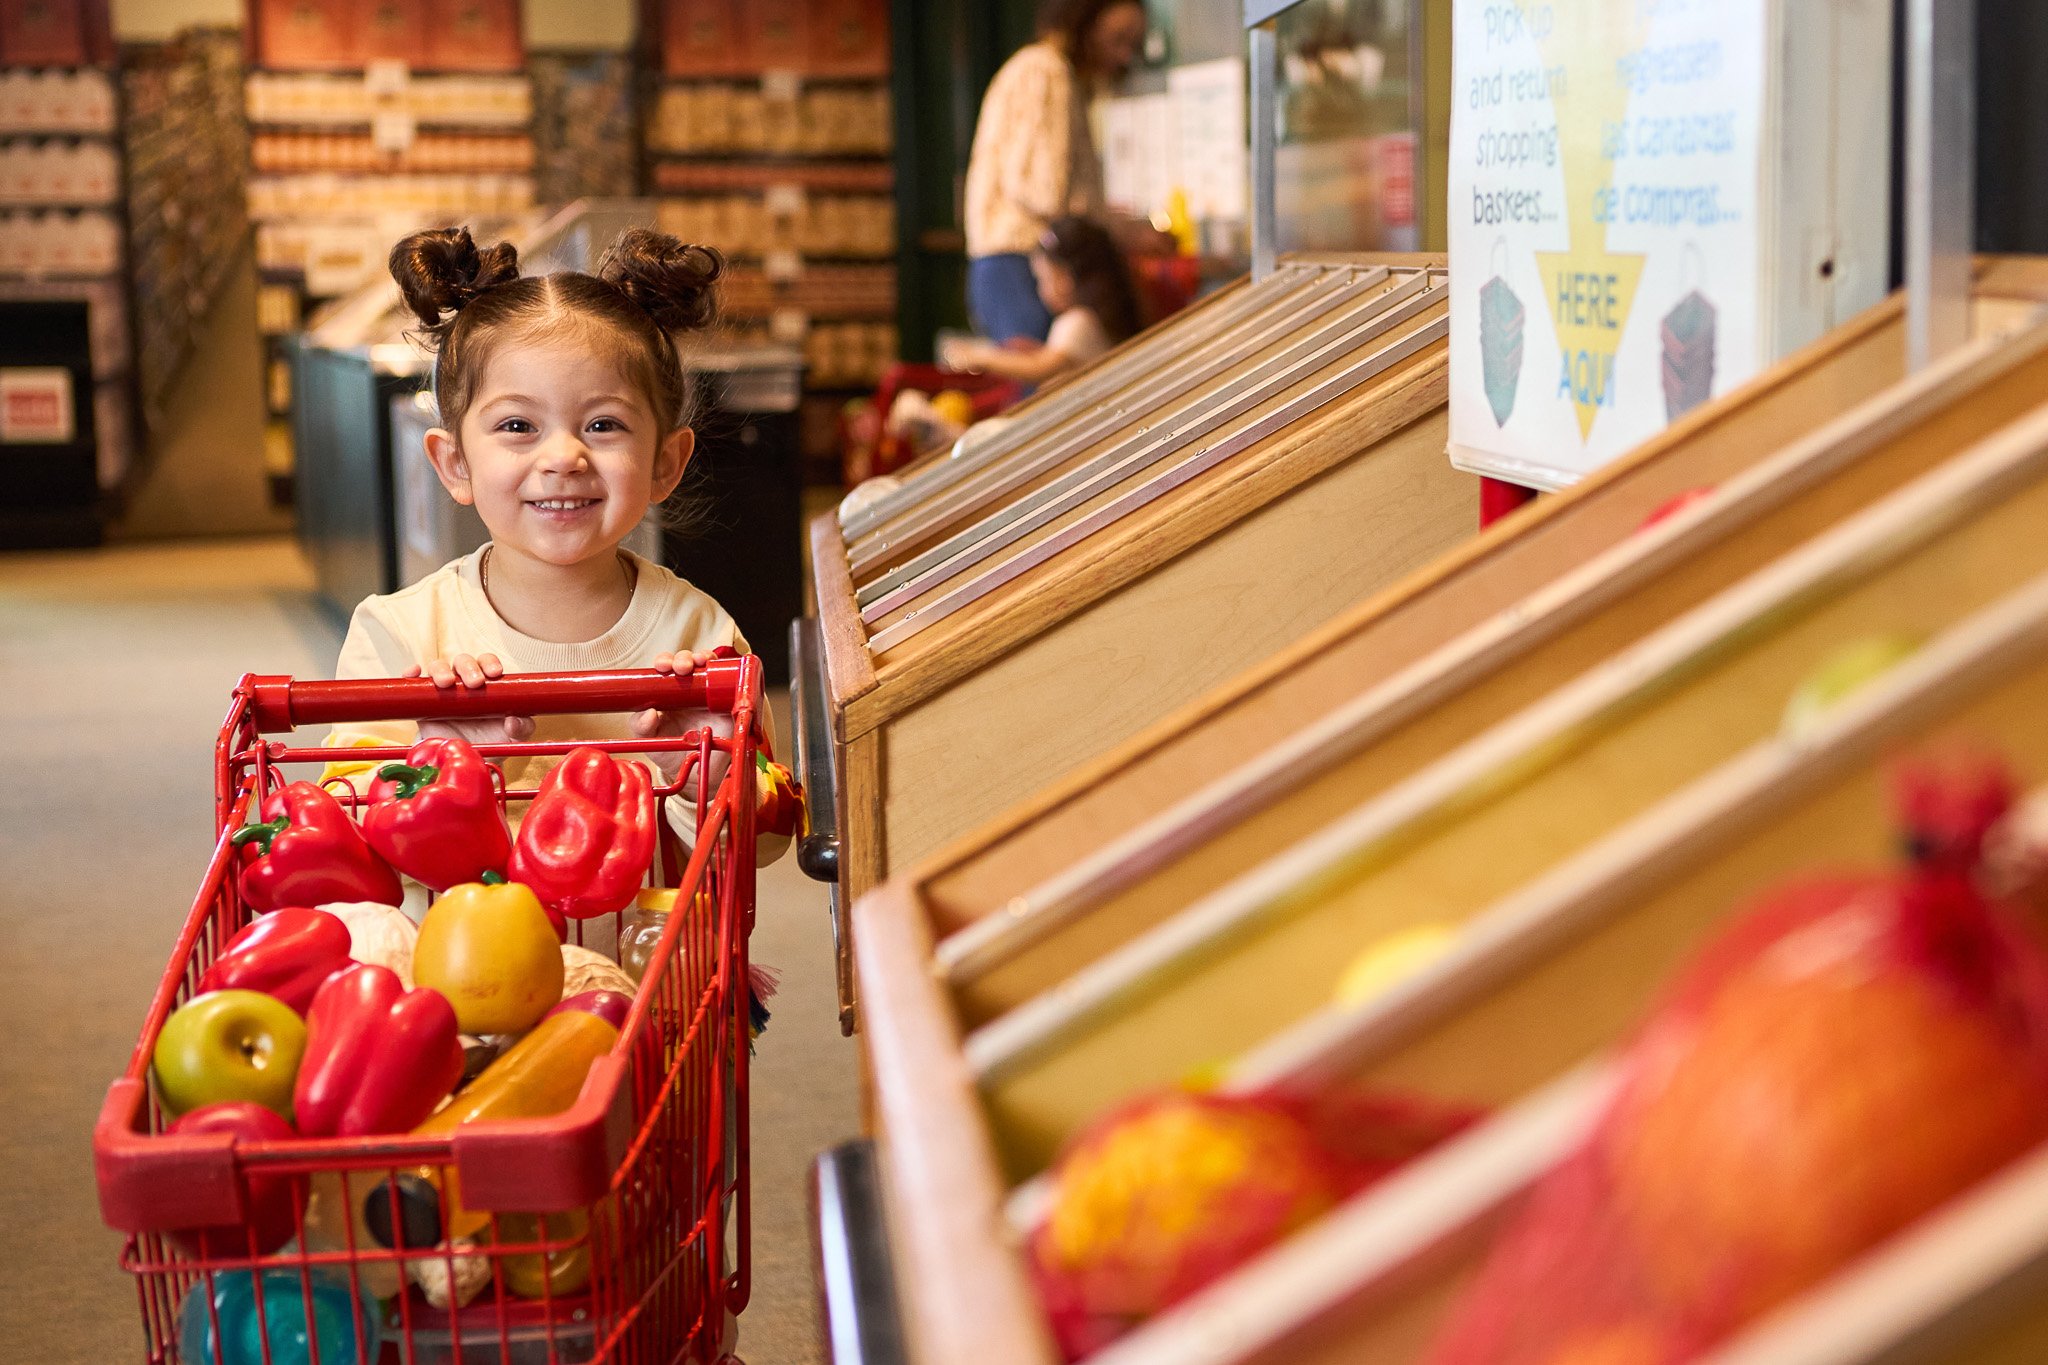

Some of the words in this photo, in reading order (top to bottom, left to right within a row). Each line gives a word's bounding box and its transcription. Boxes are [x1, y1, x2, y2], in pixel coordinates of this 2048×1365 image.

[1470, 65, 1503, 110] and
[1509, 63, 1568, 101] return
[1476, 120, 1558, 168] shopping
[1472, 184, 1559, 225] baskets...
[1556, 271, 1619, 329] HERE
